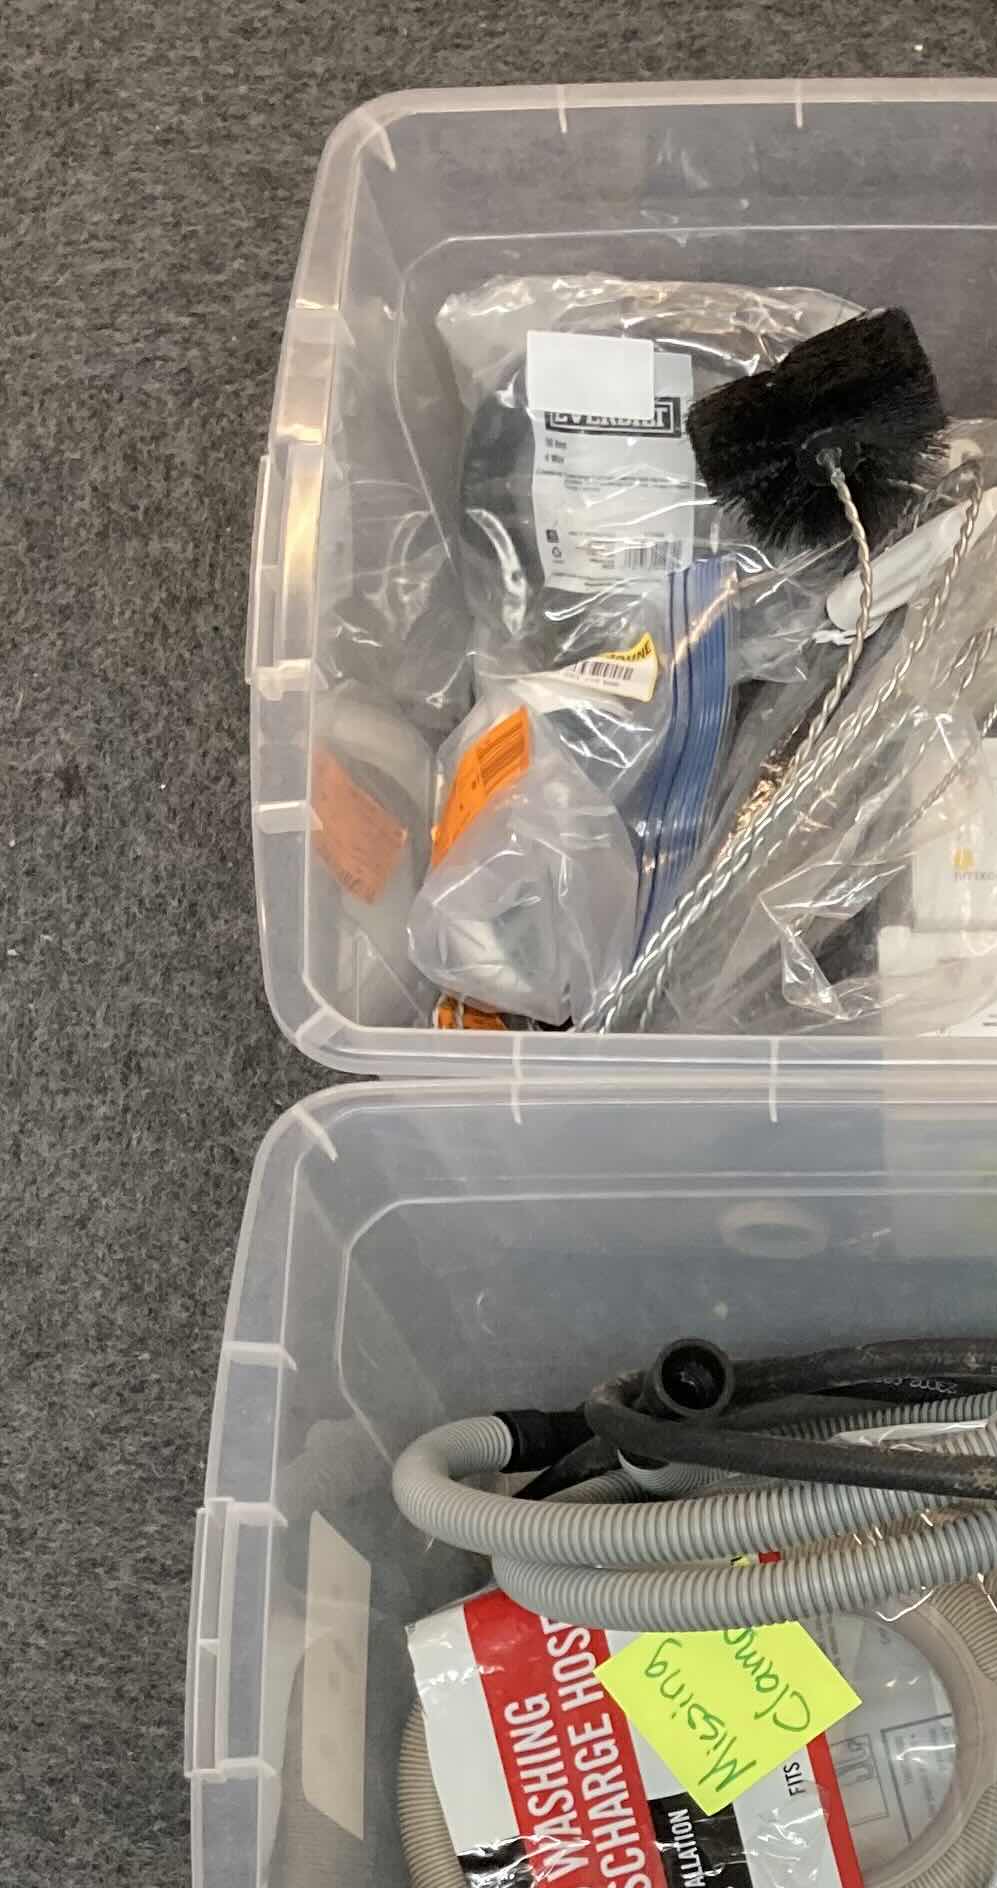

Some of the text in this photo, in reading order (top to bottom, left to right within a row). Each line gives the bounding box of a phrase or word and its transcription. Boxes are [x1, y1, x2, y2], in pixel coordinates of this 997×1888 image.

[503, 1693, 579, 1882] WASHING
[644, 1637, 757, 1793] Missing
[784, 1761, 806, 1796] FITS
